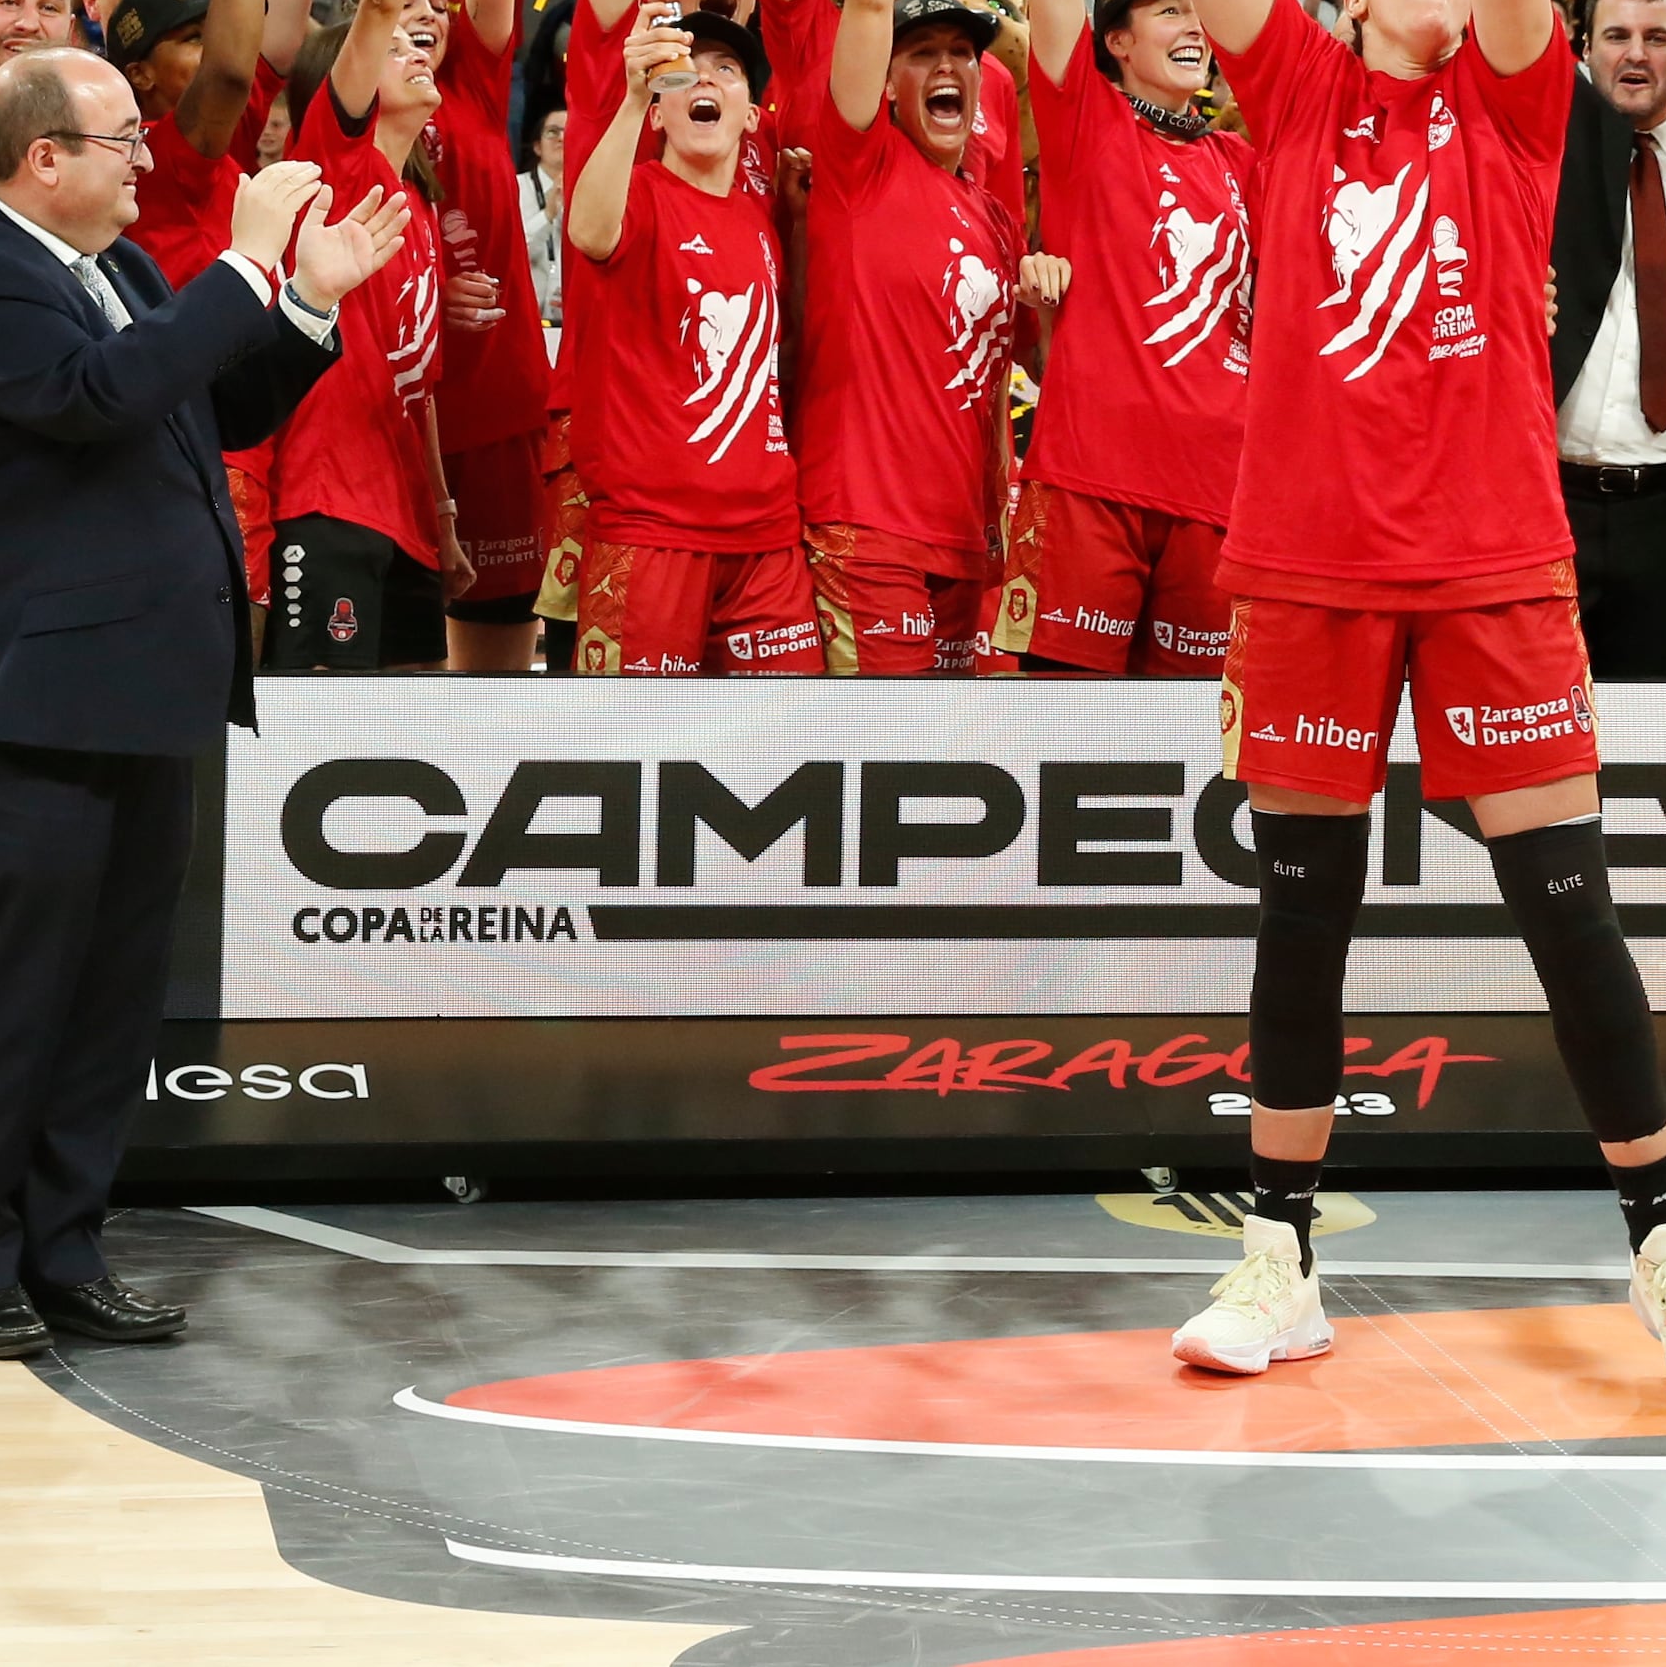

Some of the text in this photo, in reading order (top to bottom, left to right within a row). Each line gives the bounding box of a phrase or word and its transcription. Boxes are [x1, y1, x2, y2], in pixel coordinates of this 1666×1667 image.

[1435, 303, 1474, 325] COPA
[478, 534, 534, 552] Zaragoza
[755, 621, 815, 643] Zaragoza
[1074, 606, 1136, 637] hiberus
[757, 635, 818, 659] DEPORTE
[1480, 697, 1569, 726] Zaragoza
[1249, 731, 1287, 742] MERCURY
[1483, 718, 1574, 747] DEPORTE
[1273, 858, 1306, 879] ÉLITE
[1547, 872, 1584, 895] ÉLITE
[292, 906, 578, 944] COPA DE REINA
[420, 925, 444, 943] LA
[1208, 1092, 1397, 1117] 23
